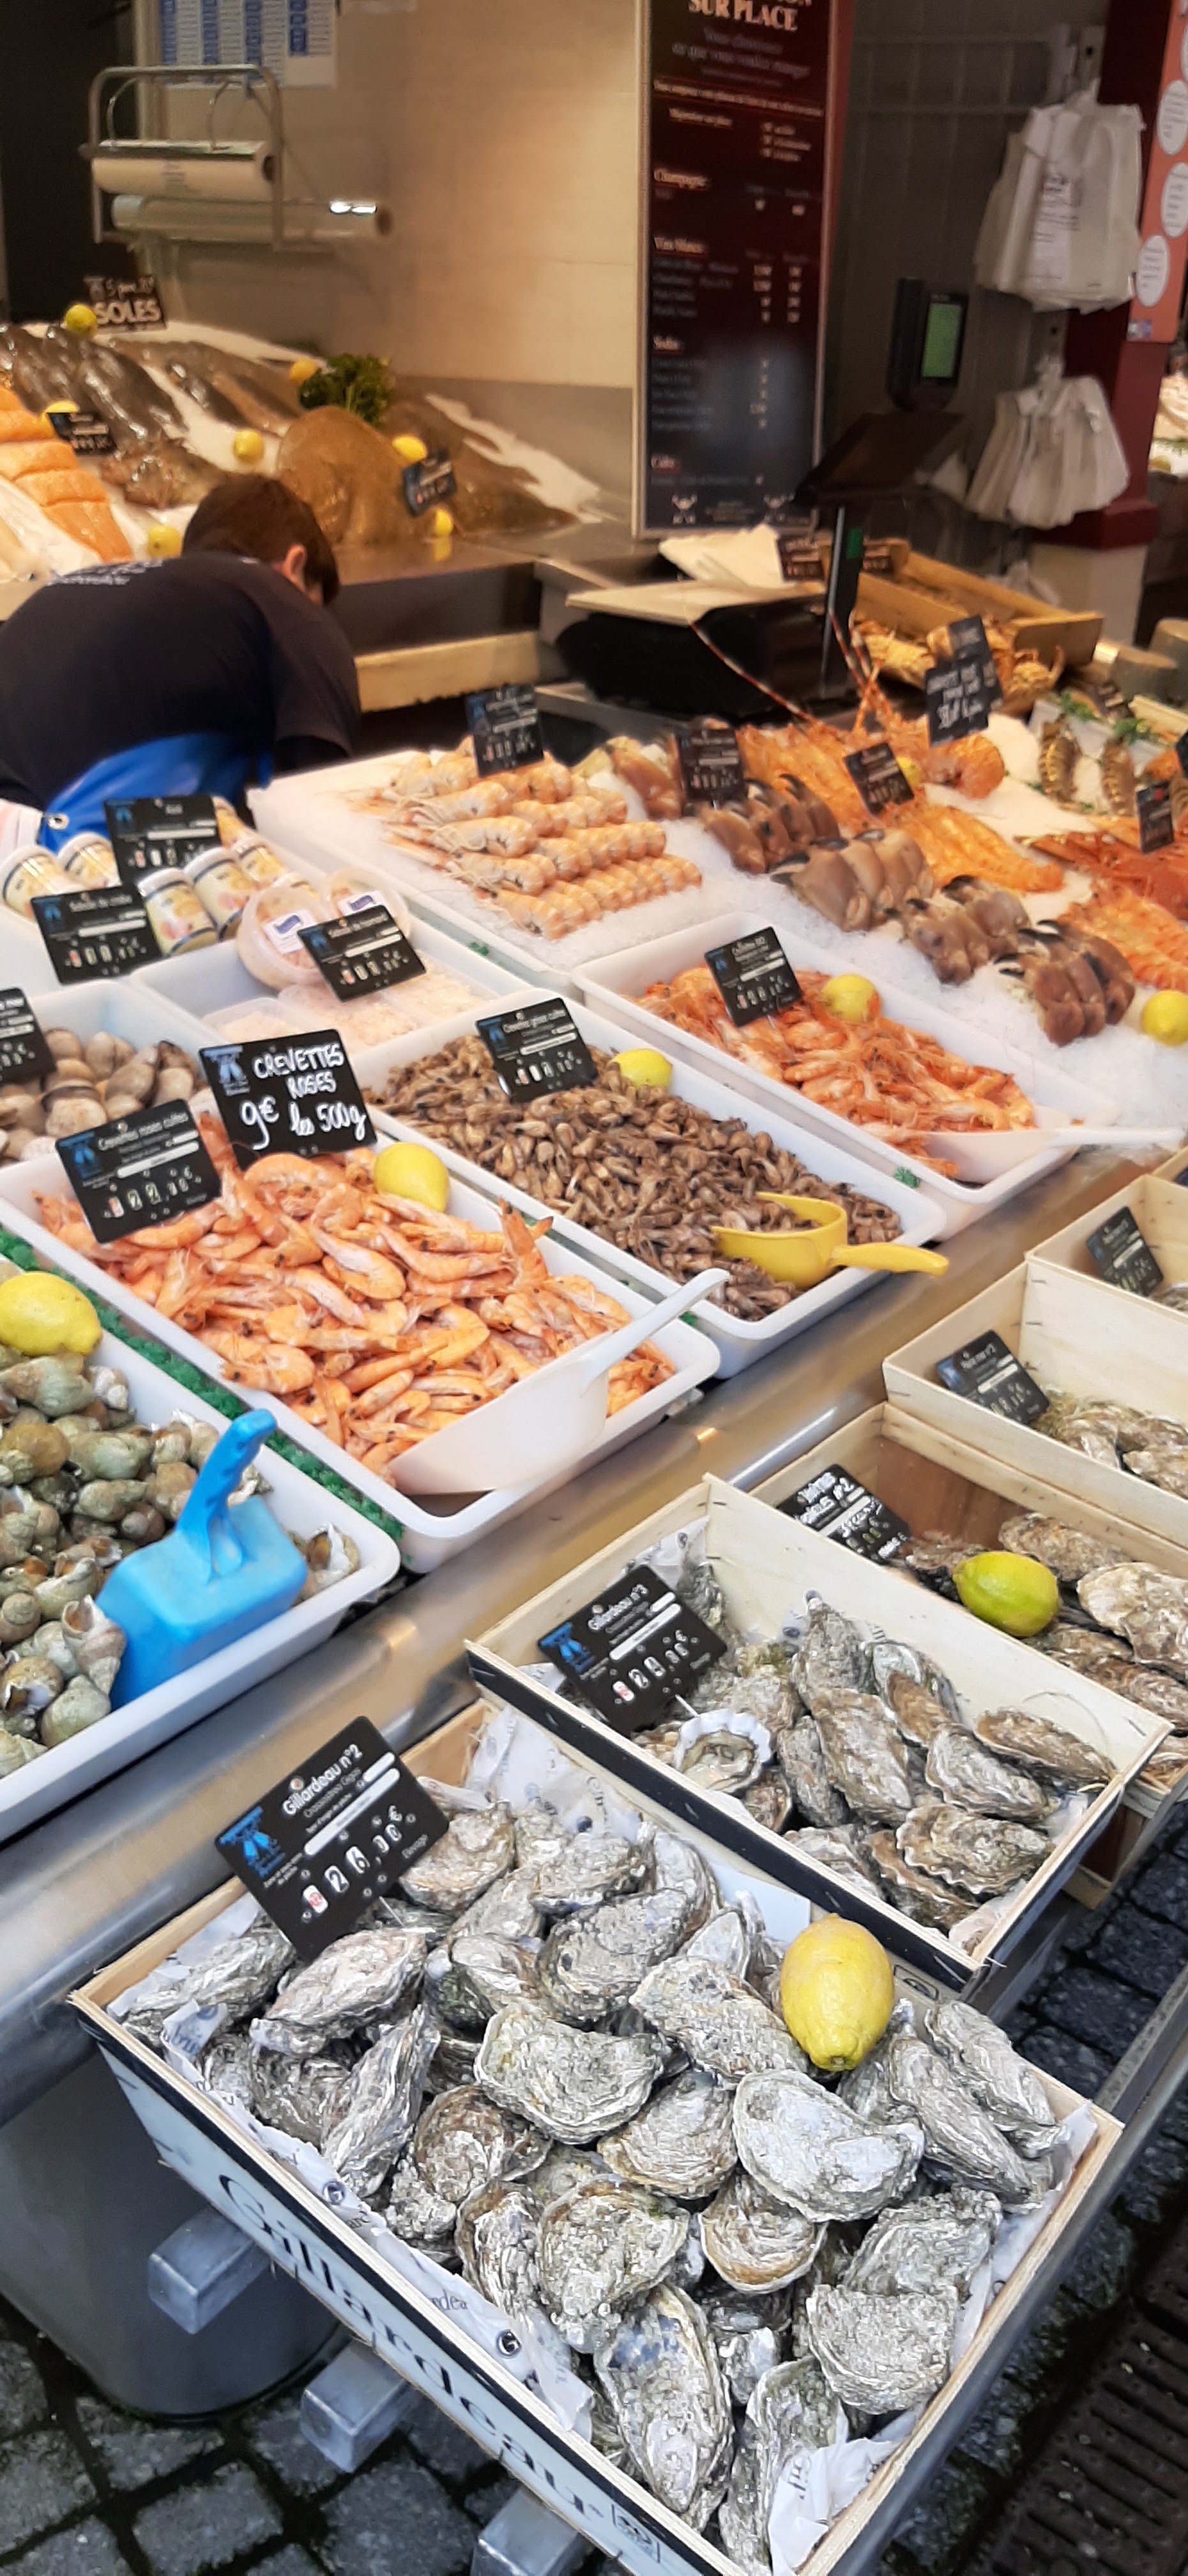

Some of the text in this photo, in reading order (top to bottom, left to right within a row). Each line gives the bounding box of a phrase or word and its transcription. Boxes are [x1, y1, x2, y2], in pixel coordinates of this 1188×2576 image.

[735, 0, 798, 31] PLACE
[94, 299, 161, 325] SOLES
[252, 1043, 345, 1080] CREVETTES
[286, 1070, 337, 1100] ROSES
[316, 1101, 367, 1141] 500g
[282, 1744, 363, 1814] Gillardeau n°2
[218, 2174, 586, 2516] Gillardeau
